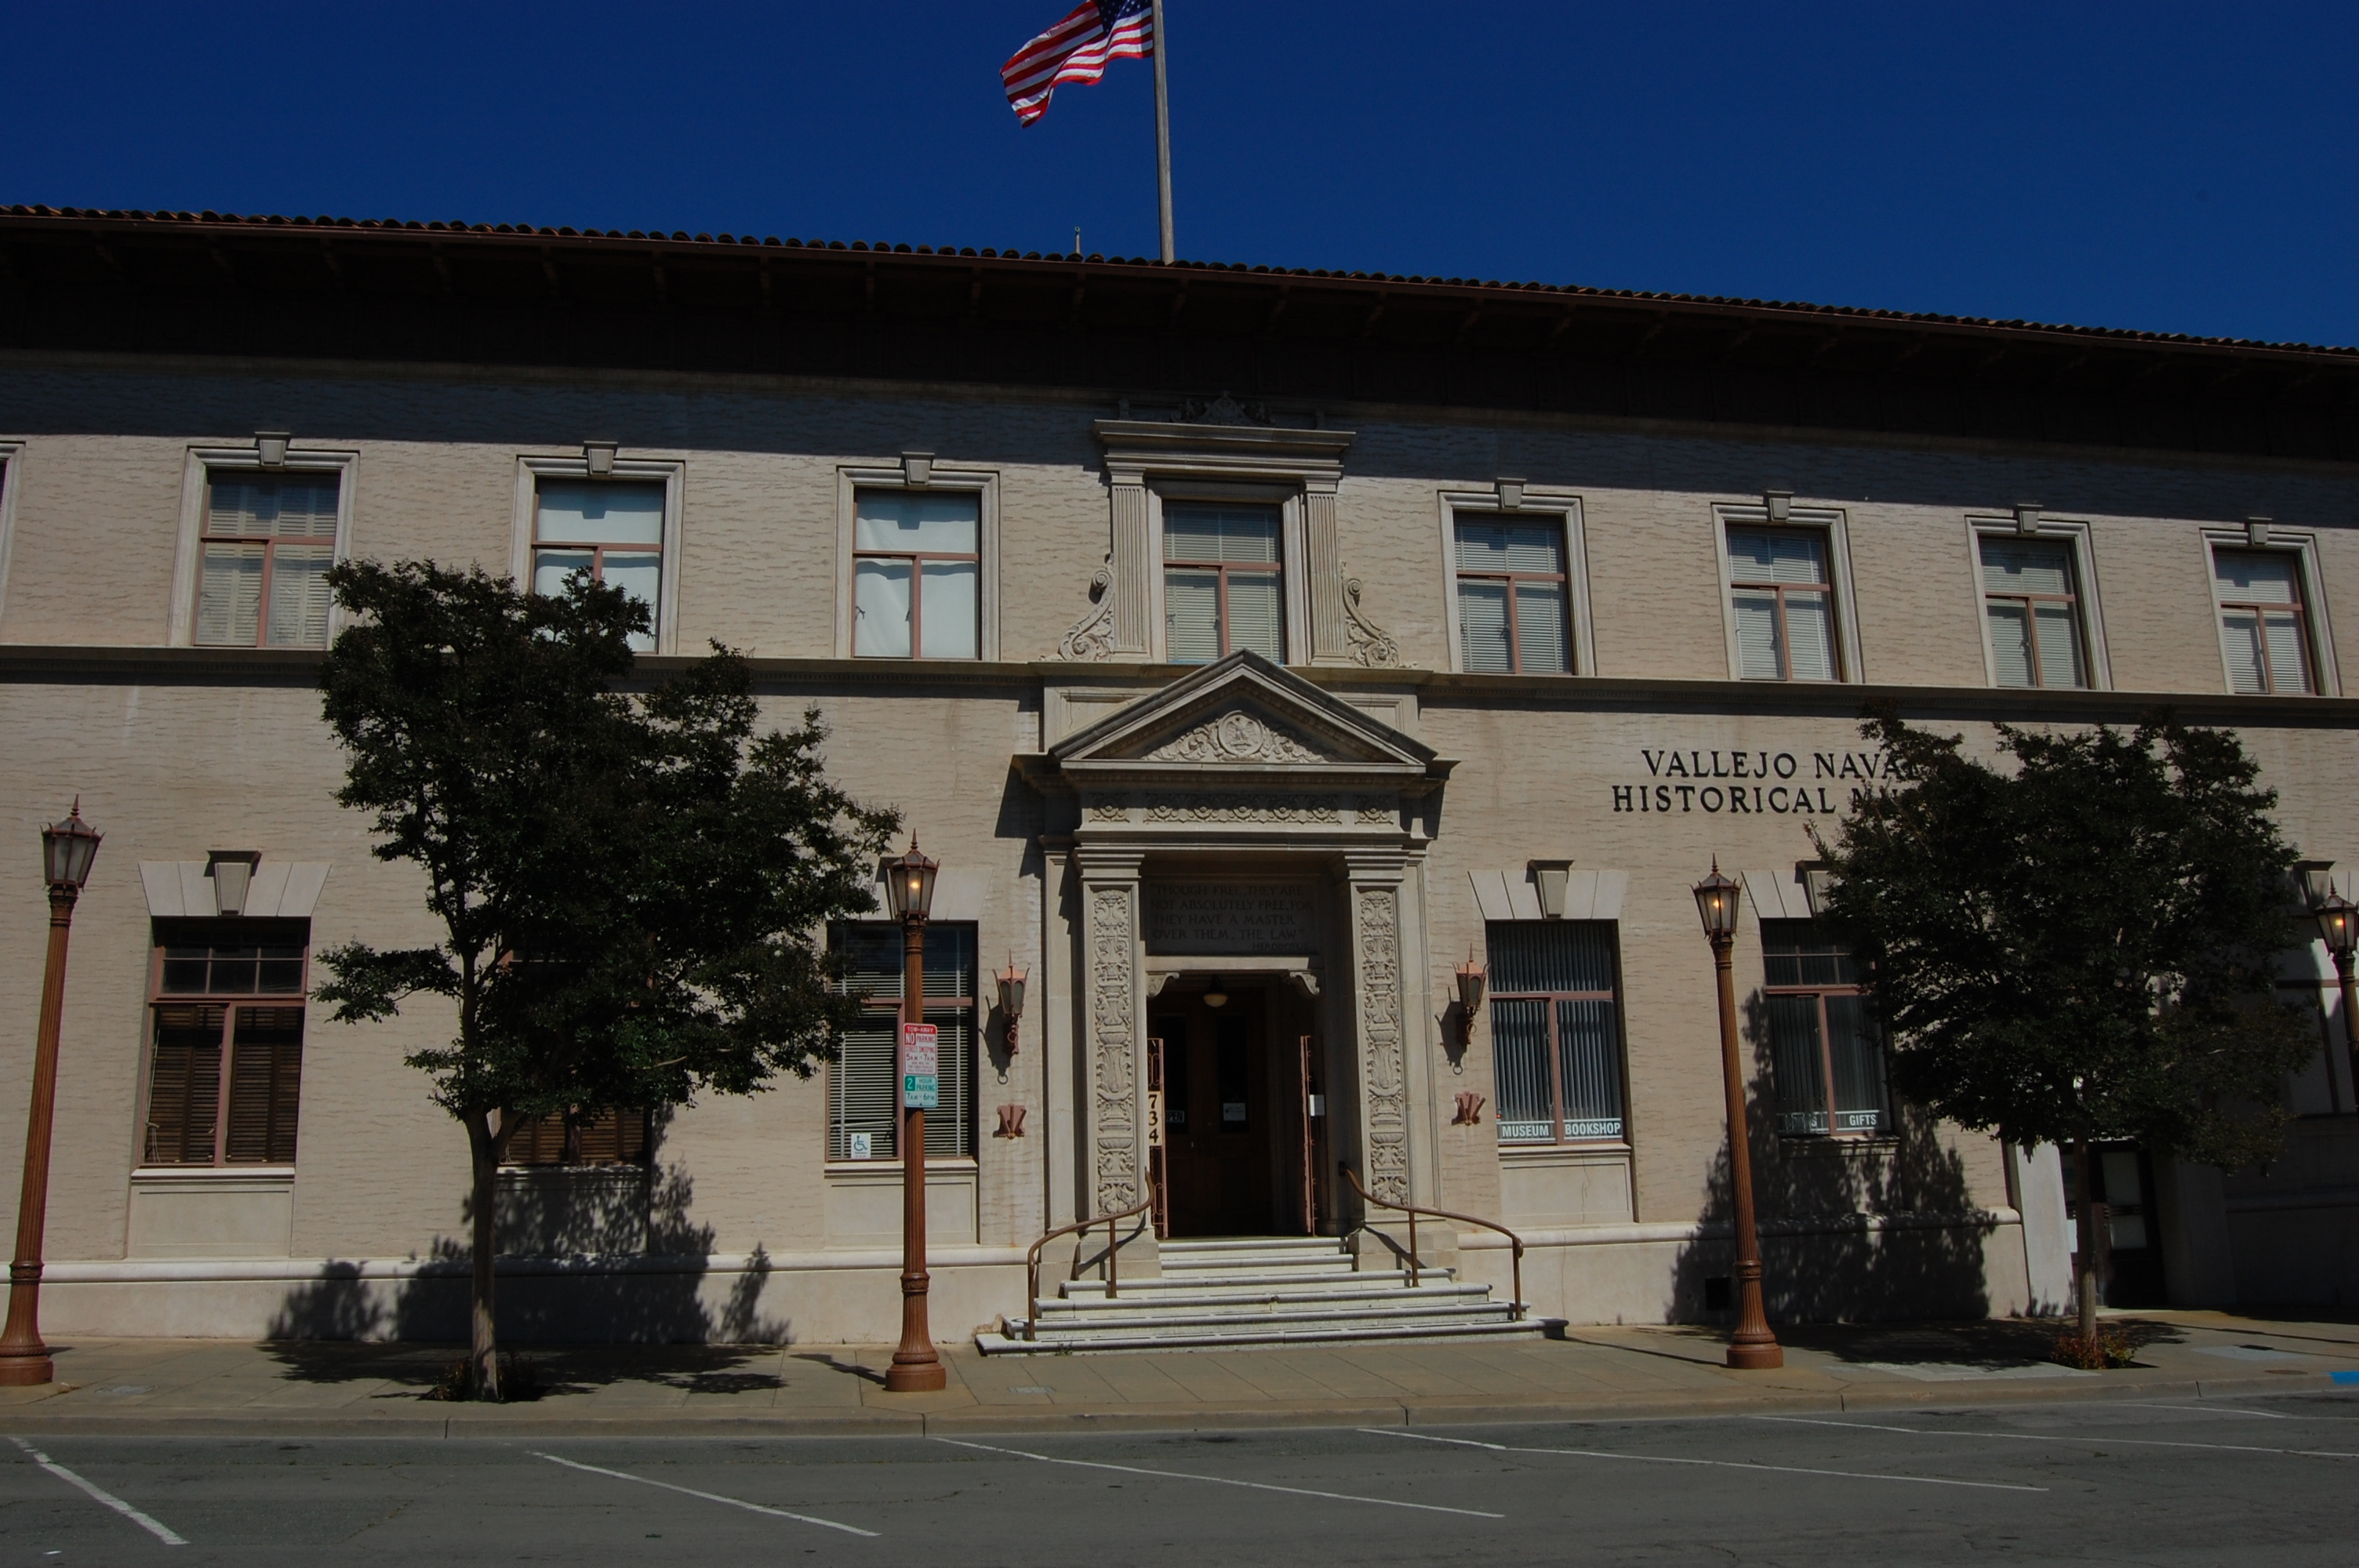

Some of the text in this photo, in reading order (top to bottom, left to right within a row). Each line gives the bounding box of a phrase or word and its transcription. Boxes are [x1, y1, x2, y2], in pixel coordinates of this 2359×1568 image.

[1641, 750, 1797, 780] VALLEJO
[1612, 785, 1837, 814] HISTORICAL
[1248, 885, 1276, 895] THEY
[1280, 885, 1304, 895] ARE
[1150, 900, 1175, 910] NOT
[1180, 900, 1255, 911] ABSOLUTELY
[1153, 914, 1296, 925] THEY HAVE A MASTER
[1152, 929, 1187, 939] OVER
[1238, 929, 1263, 940] THE
[1252, 942, 1309, 951] HERODOTUS
[906, 1033, 915, 1044] NO
[907, 1077, 913, 1089] 2
[1849, 1113, 1877, 1127] GIFTS
[1502, 1122, 1621, 1138] MUSEUM BOOKSHOP
